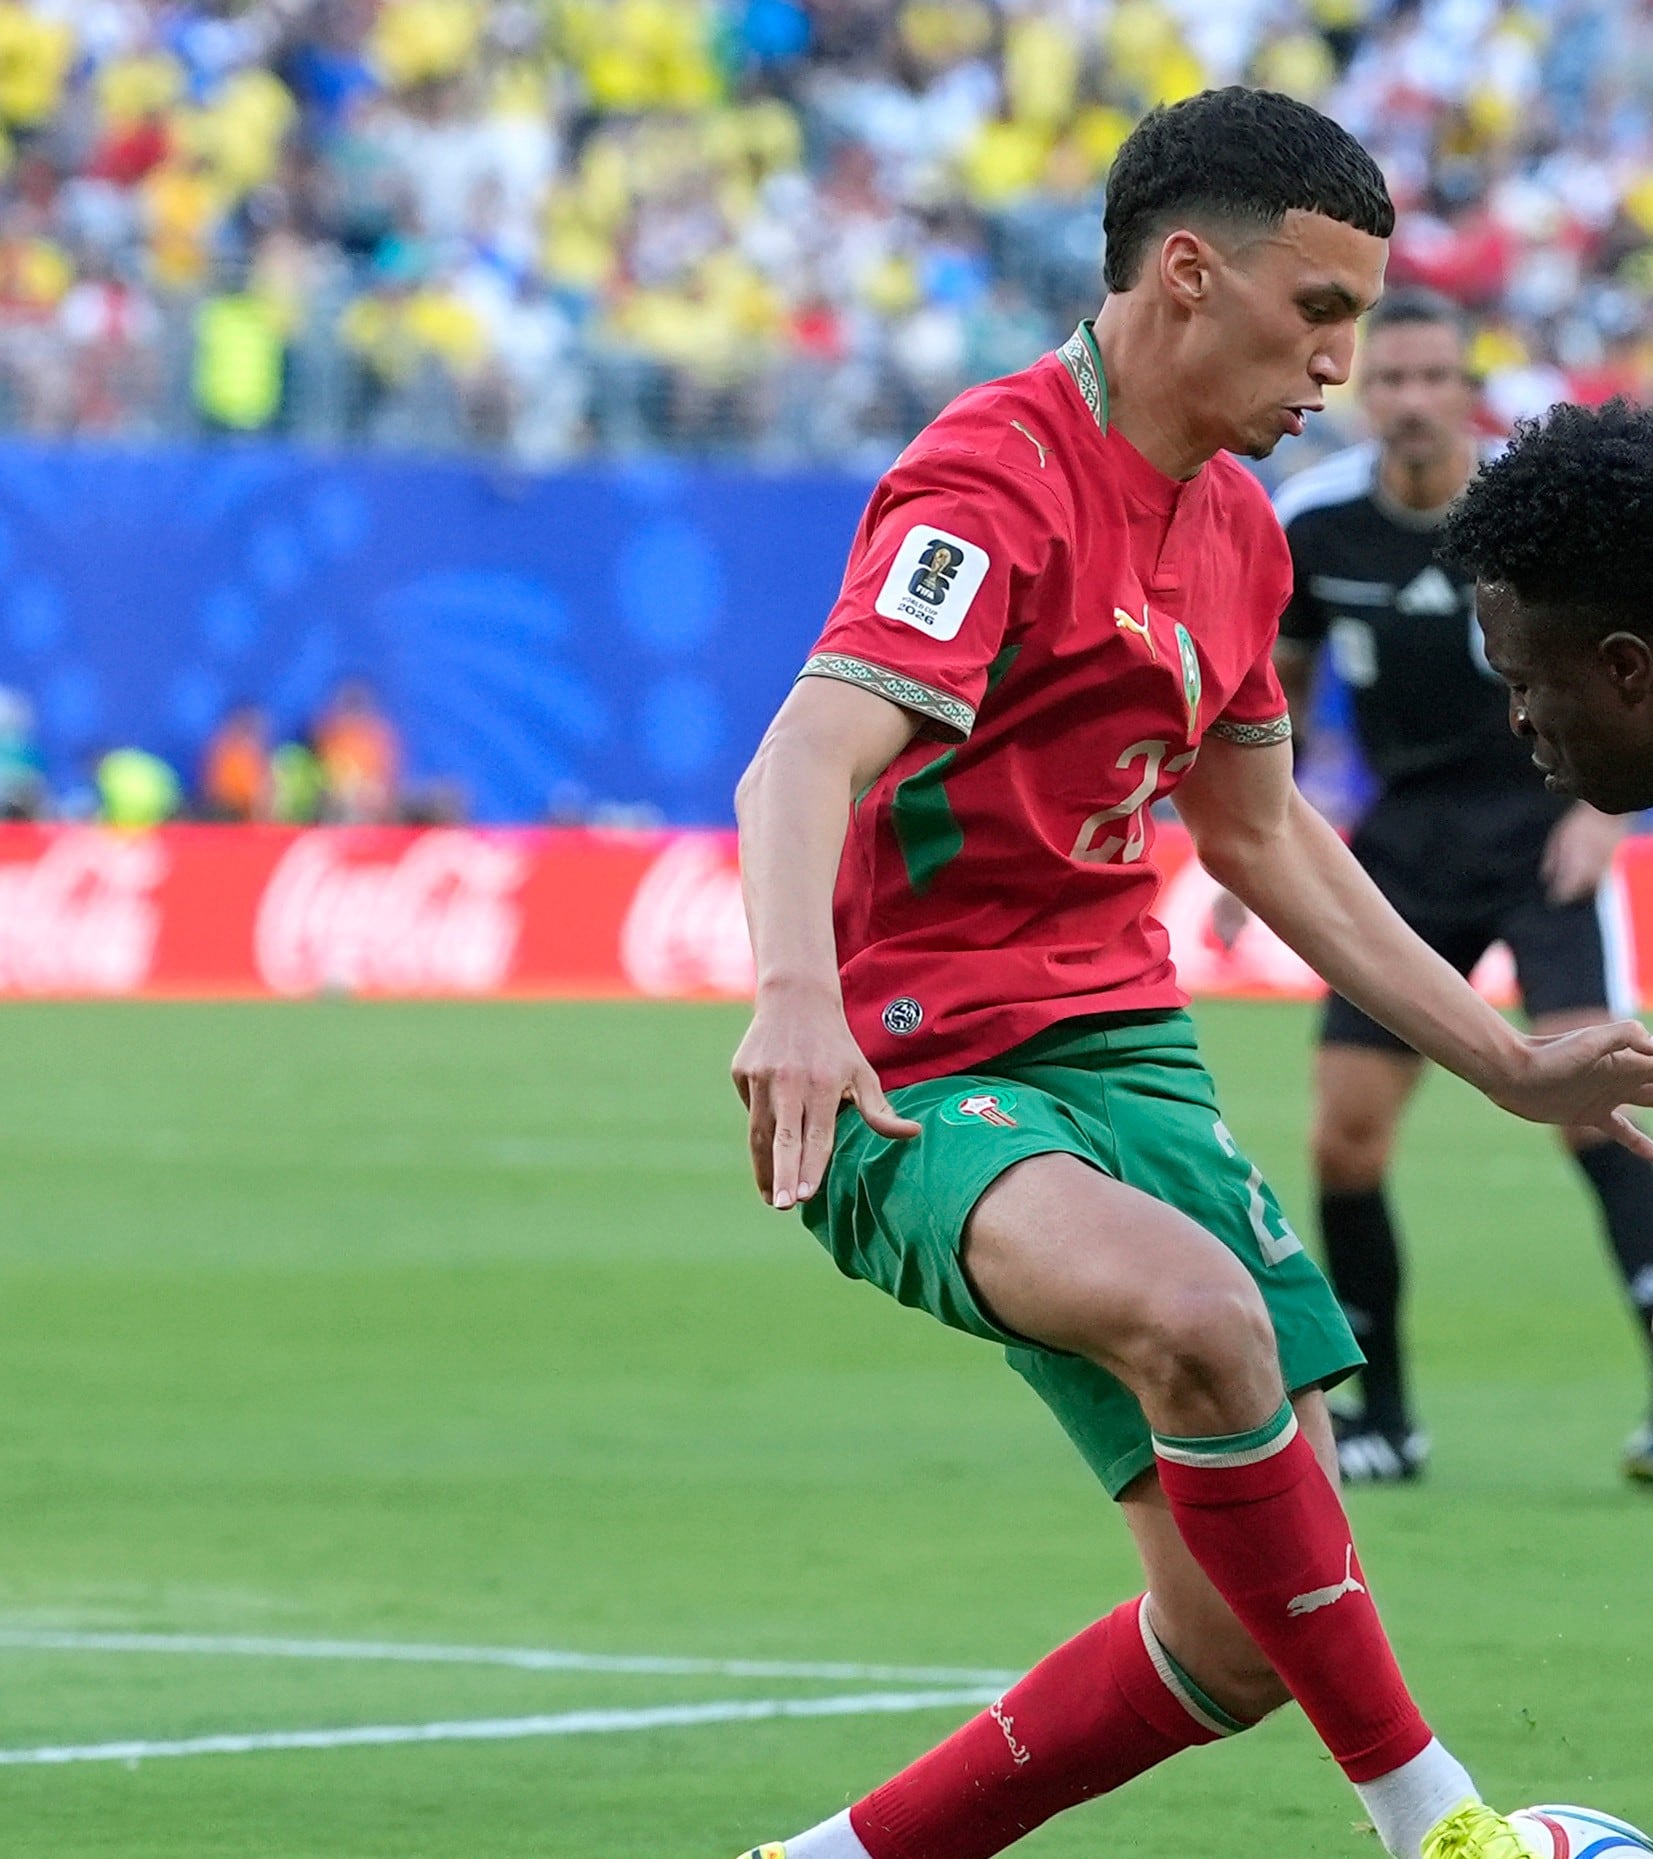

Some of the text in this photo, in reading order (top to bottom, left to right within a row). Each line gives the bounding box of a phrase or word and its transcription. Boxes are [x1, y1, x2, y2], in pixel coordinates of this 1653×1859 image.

[915, 584, 936, 600] FIFA
[897, 603, 935, 625] 2026
[924, 605, 939, 616] CUP
